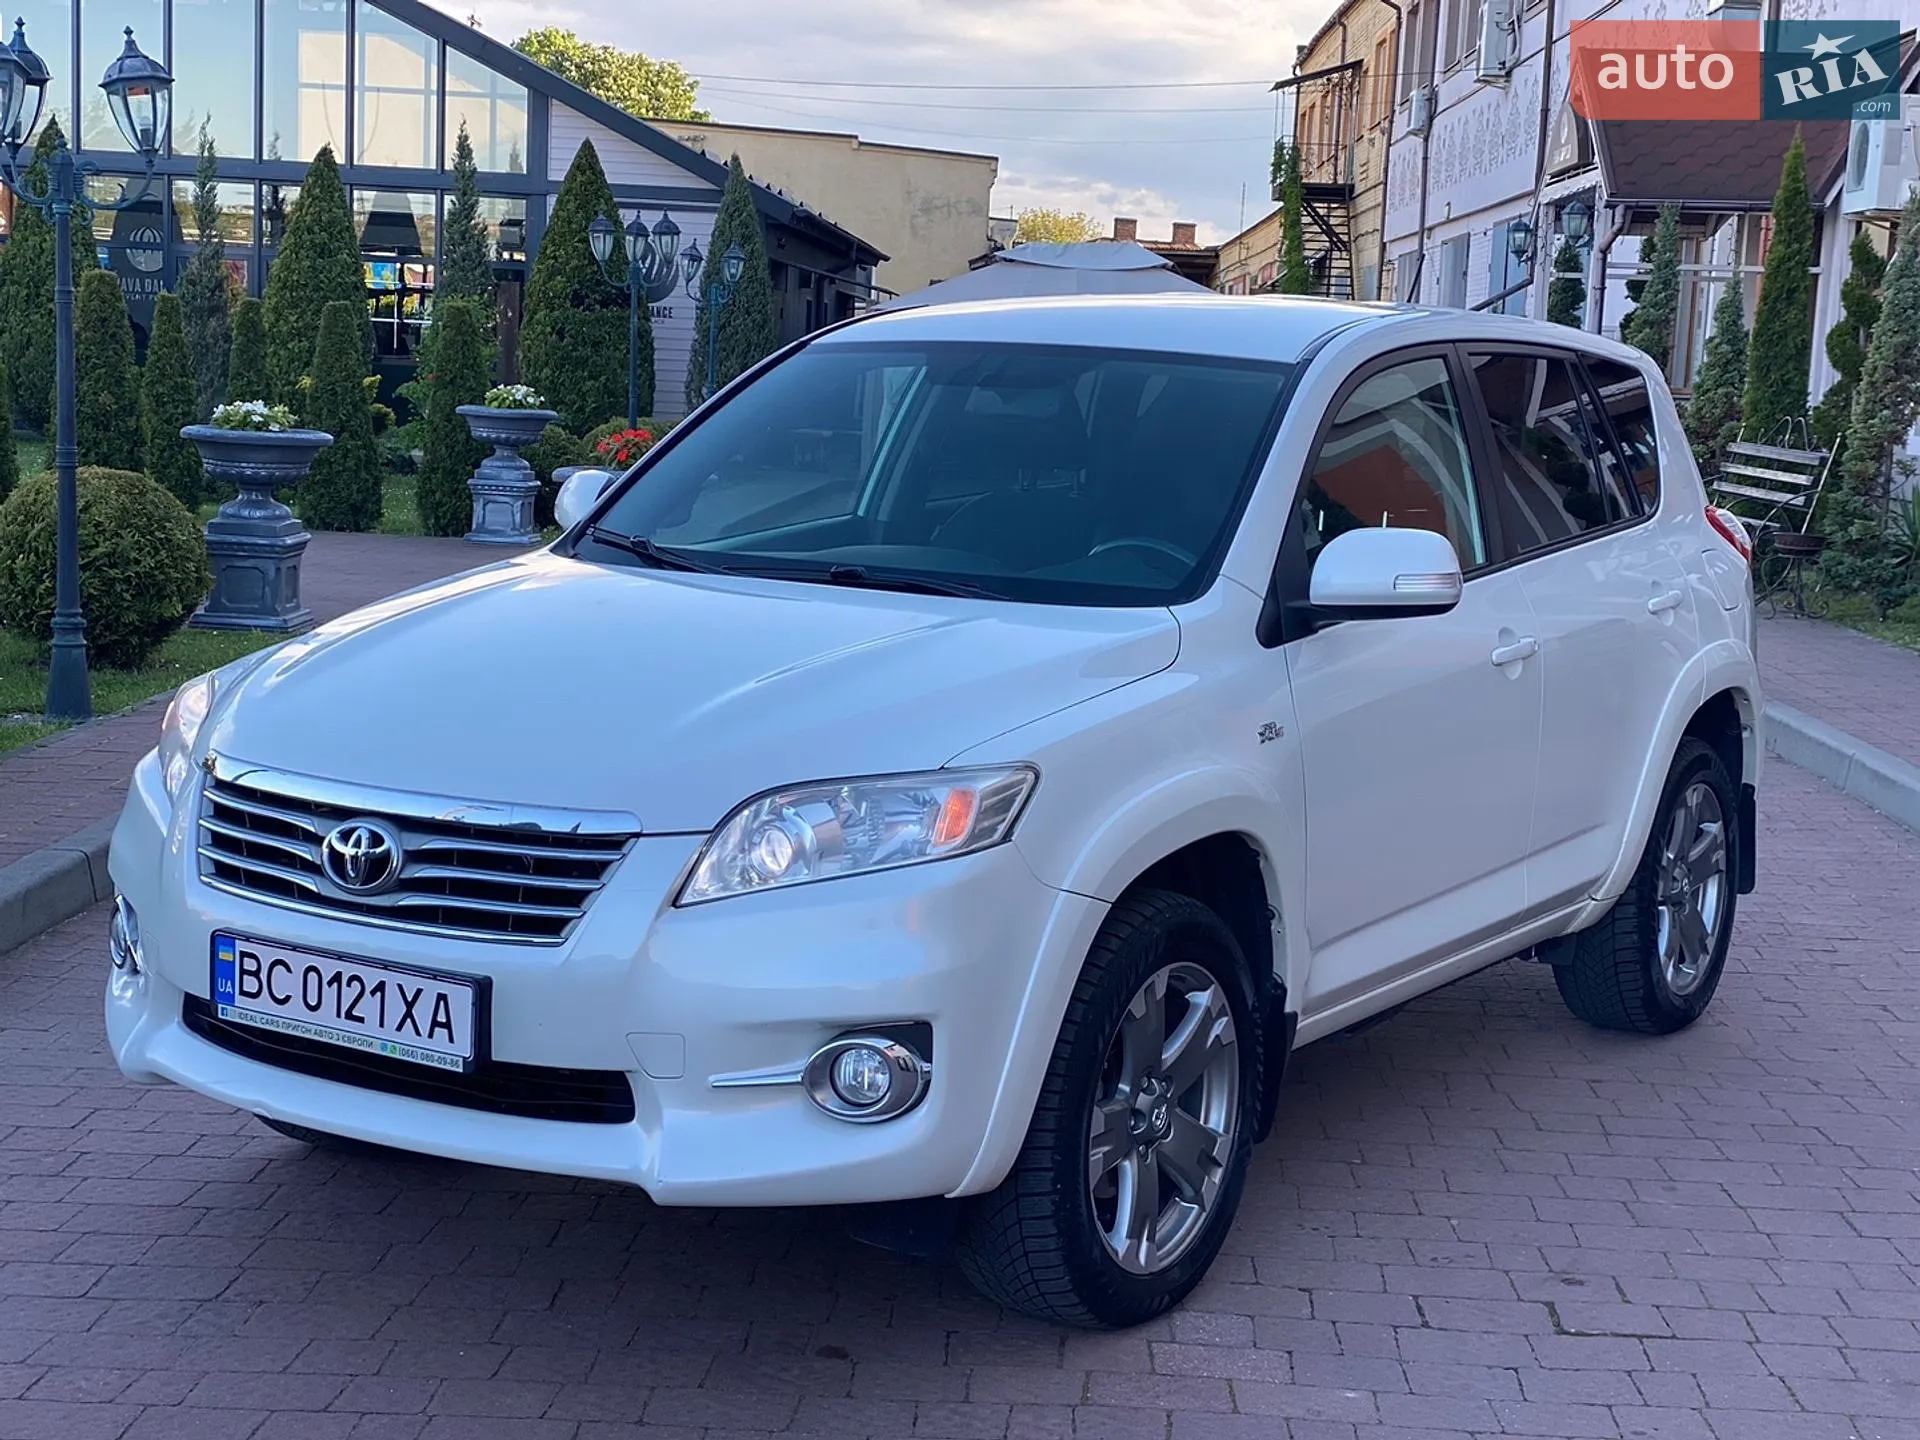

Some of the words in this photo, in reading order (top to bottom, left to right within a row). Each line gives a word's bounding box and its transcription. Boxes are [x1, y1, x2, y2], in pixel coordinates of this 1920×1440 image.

[648, 306, 673, 319] ANCE
[218, 977, 234, 995] UA
[238, 949, 294, 1006] BC
[302, 963, 388, 1029] 0121
[394, 982, 455, 1044] XA
[238, 1011, 258, 1024] IDEAL
[260, 1017, 280, 1030] CARS
